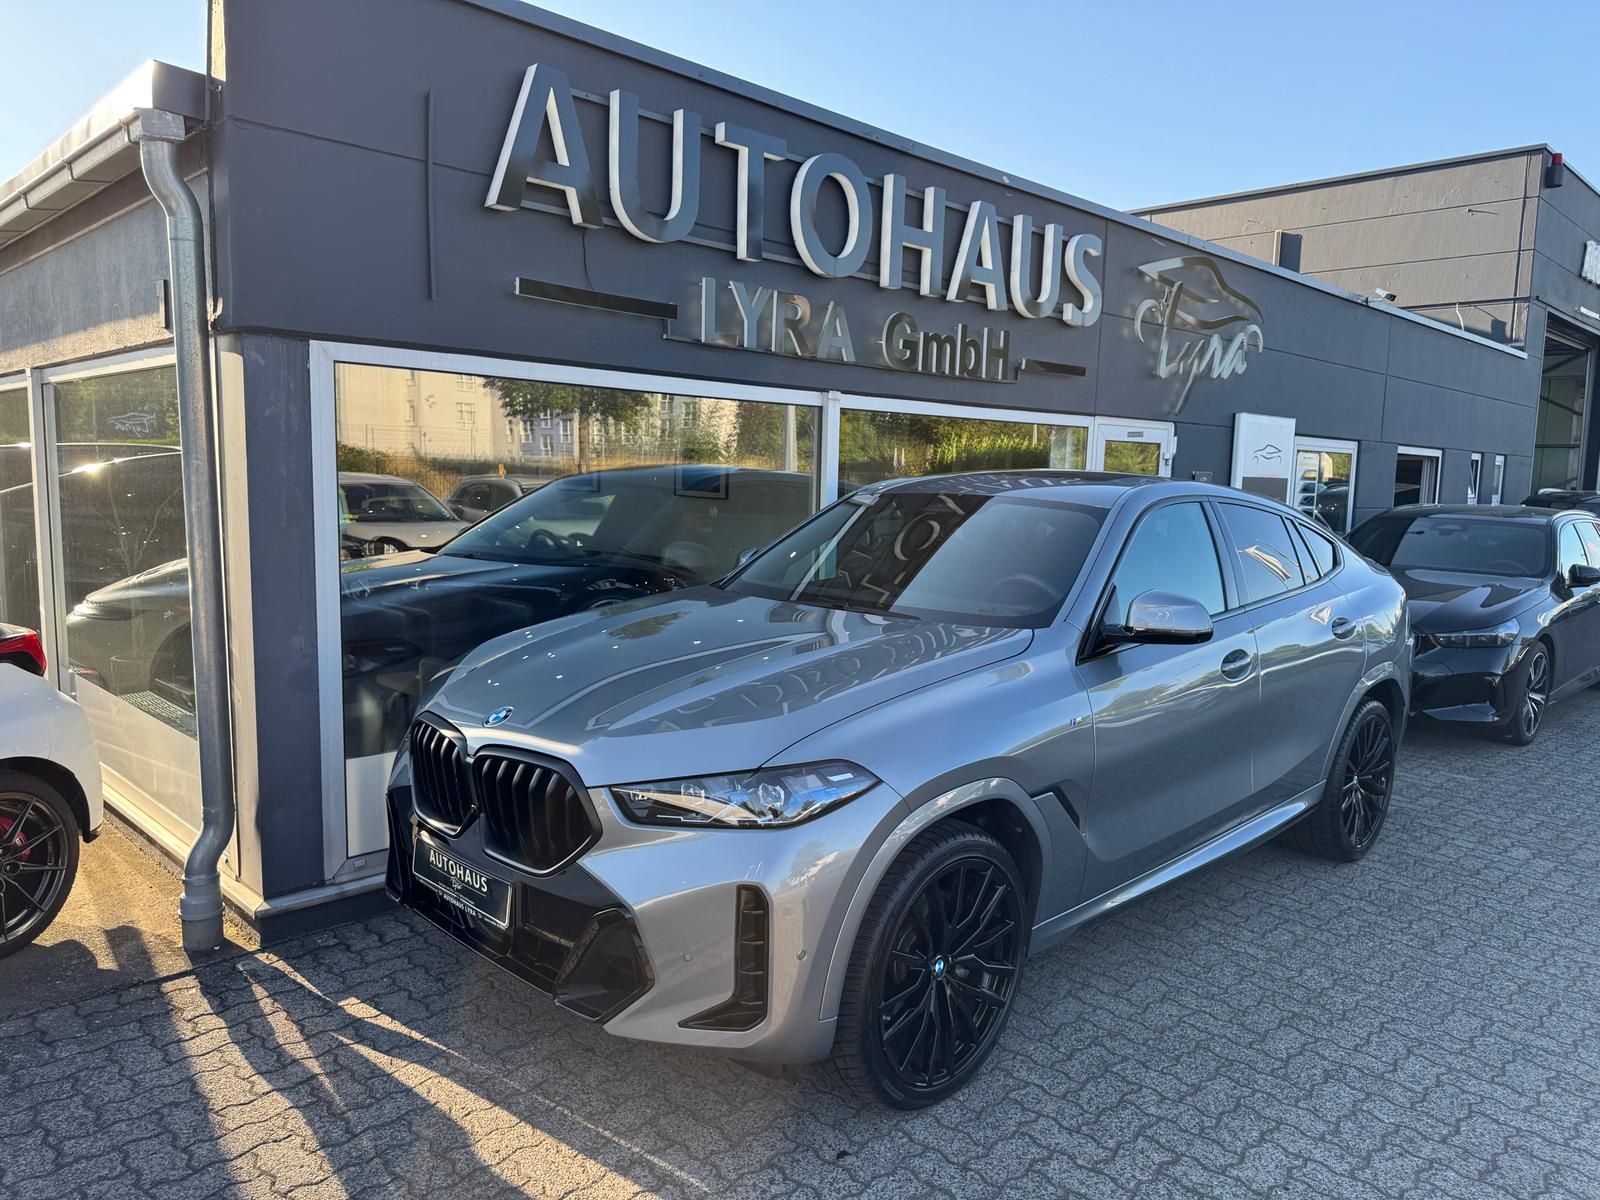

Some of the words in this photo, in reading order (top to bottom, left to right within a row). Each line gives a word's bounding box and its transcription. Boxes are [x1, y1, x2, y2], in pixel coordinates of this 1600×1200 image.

[484, 62, 1103, 328] AUTOHAUS
[701, 276, 857, 362] LYRA
[881, 311, 1010, 381] GmbH
[429, 848, 488, 893] AUTOHAUS
